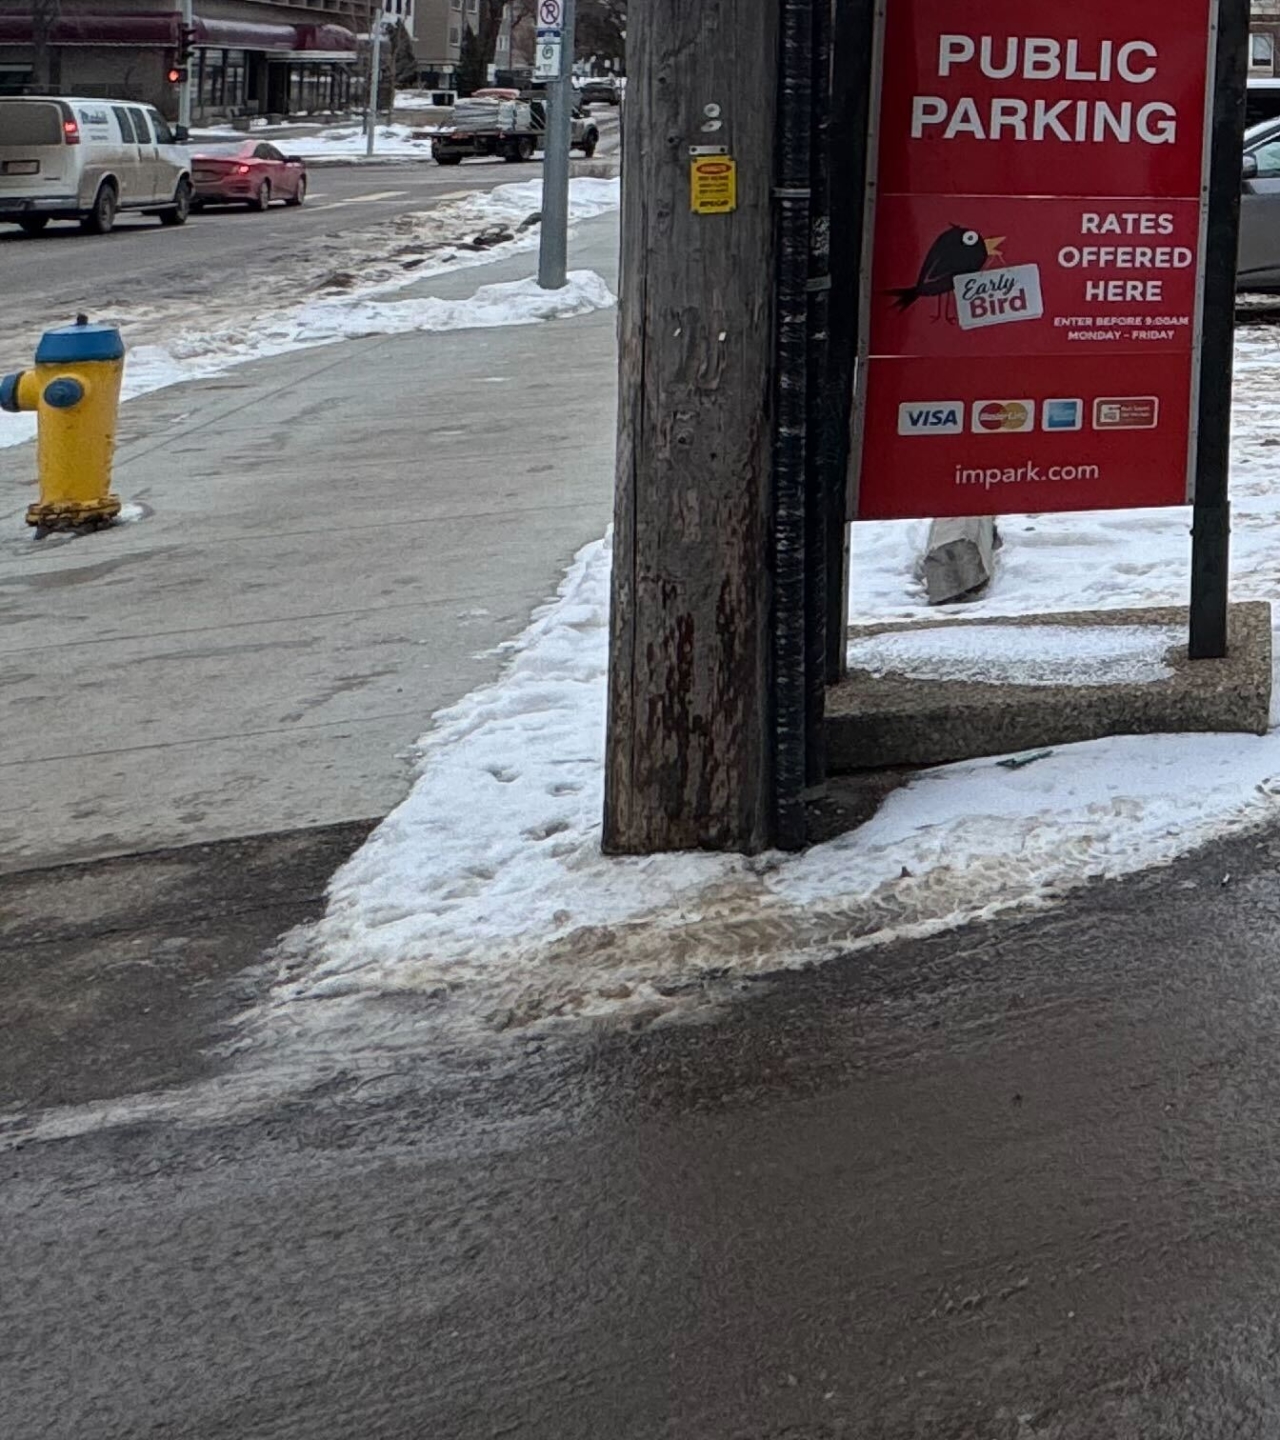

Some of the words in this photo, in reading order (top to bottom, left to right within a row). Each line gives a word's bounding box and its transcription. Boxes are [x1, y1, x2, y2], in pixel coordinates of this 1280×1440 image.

[938, 34, 1158, 82] PUBLIC
[910, 97, 1177, 144] PARKING
[1081, 213, 1174, 235] RATES
[1058, 246, 1193, 269] OFFERED
[962, 273, 1017, 301] Early
[1086, 280, 1163, 302] HERE
[969, 287, 1028, 319] Bird
[1054, 317, 1093, 327] ENTER
[1096, 316, 1143, 326] BEFORE
[1068, 330, 1121, 340] MONDAY
[1132, 330, 1175, 340] FRIDAY
[907, 410, 958, 427] VISA
[955, 462, 1099, 490] impark.com
